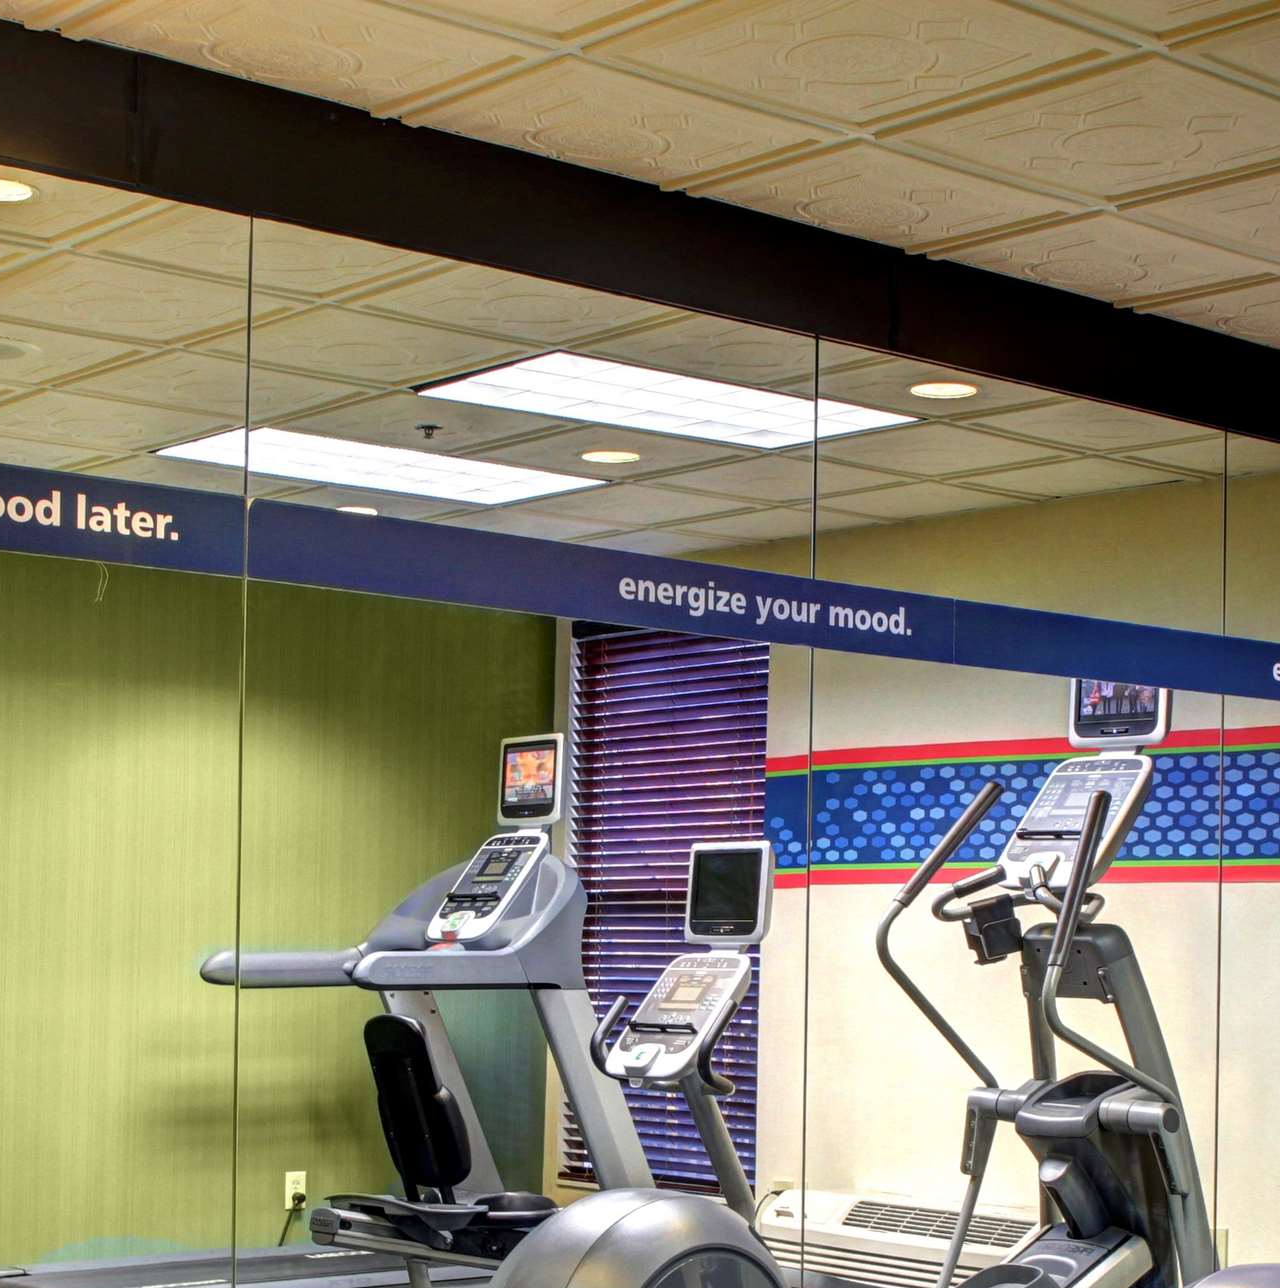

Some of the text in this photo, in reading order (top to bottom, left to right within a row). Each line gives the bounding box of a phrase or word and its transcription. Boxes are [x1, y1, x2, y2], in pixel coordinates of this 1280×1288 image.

[76, 494, 180, 542] later.
[619, 576, 912, 636] energize your mood.
